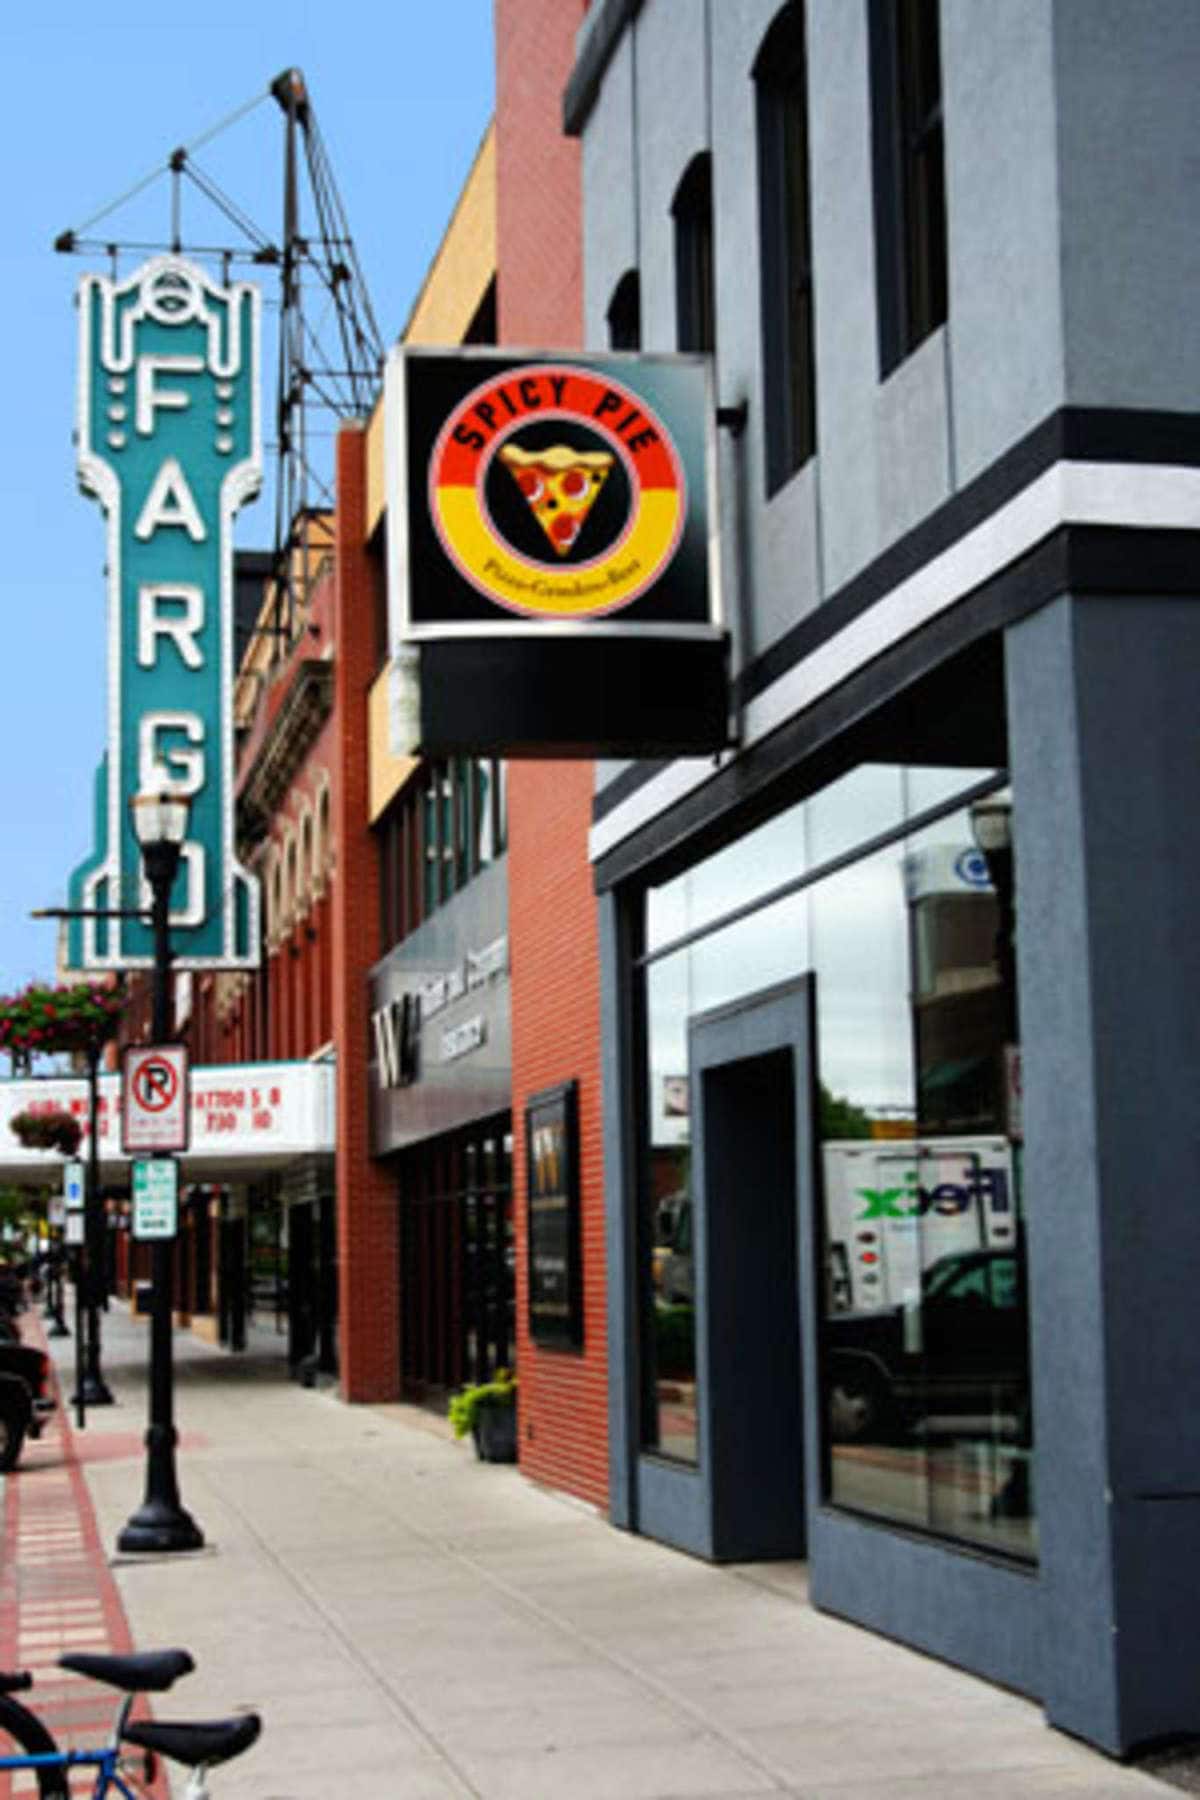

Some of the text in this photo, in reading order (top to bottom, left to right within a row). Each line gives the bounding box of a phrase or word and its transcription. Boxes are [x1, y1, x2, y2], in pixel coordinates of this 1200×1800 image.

[452, 376, 660, 453] SPICY PIE
[135, 354, 206, 929] FARGO
